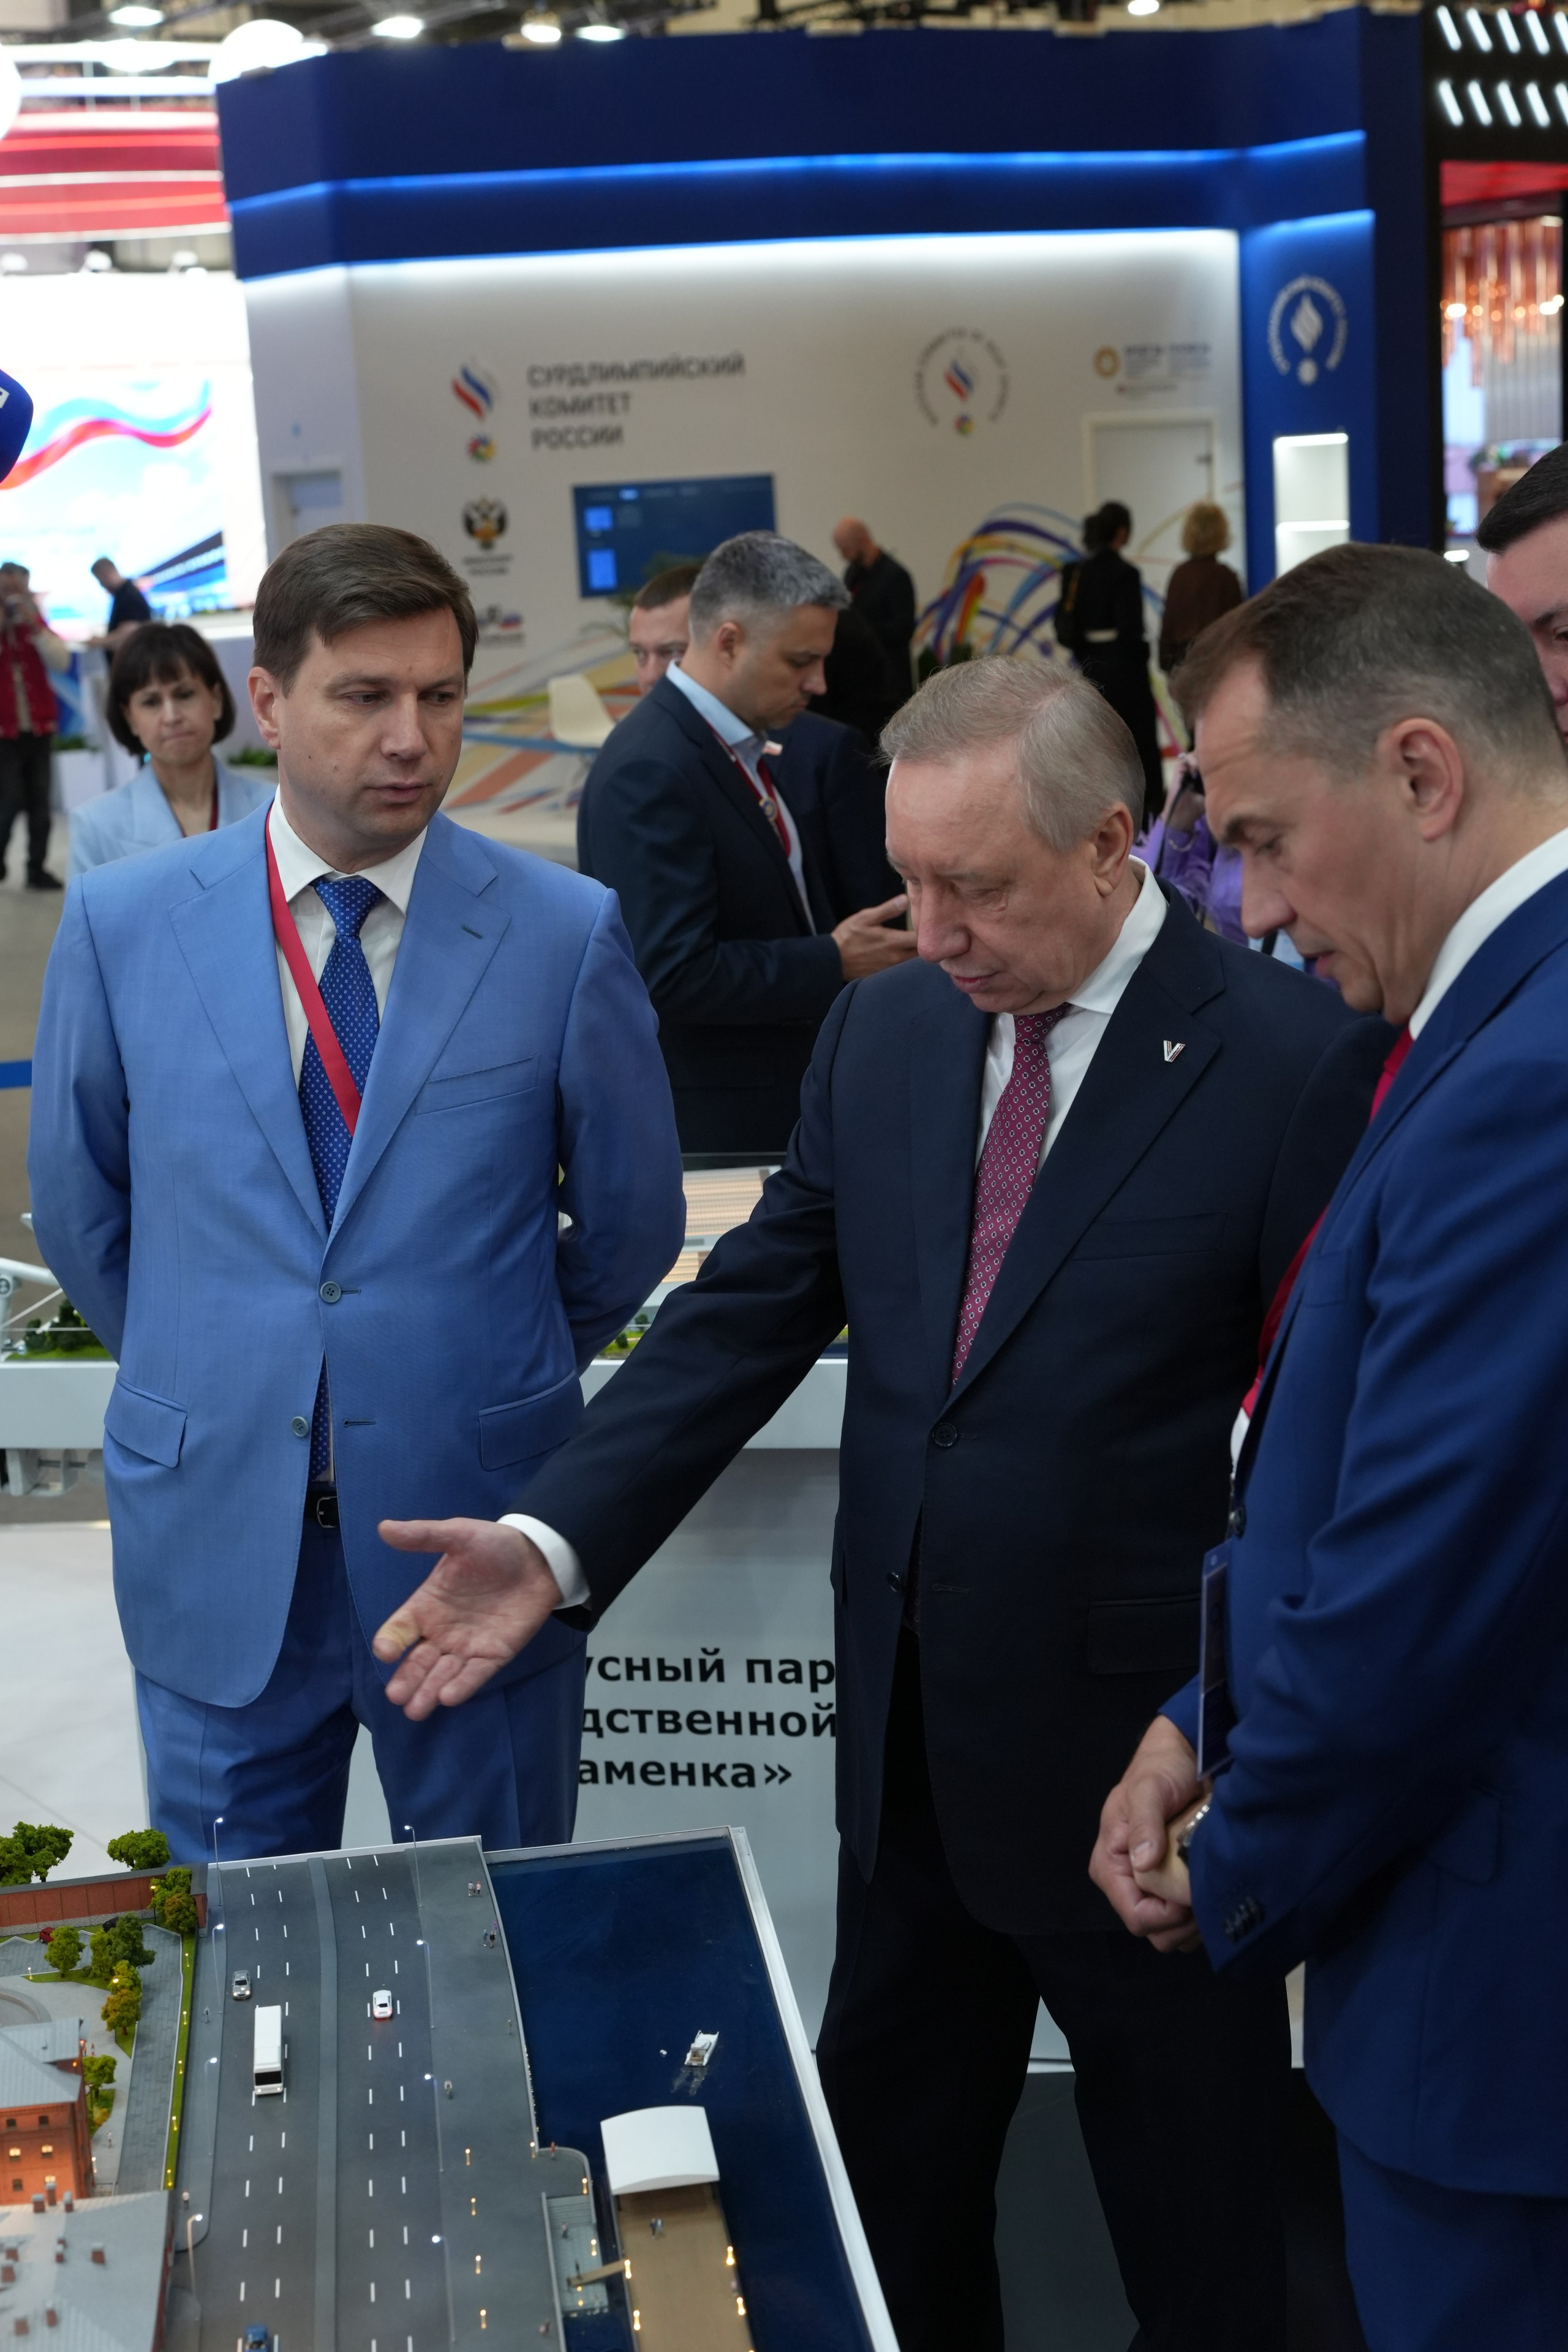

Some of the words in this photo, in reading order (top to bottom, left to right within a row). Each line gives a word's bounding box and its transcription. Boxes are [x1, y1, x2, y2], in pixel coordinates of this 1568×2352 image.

[529, 390, 630, 419] КОМИТЕТ
[531, 424, 624, 451] РОССИИ
[745, 1657, 835, 1693] пар
